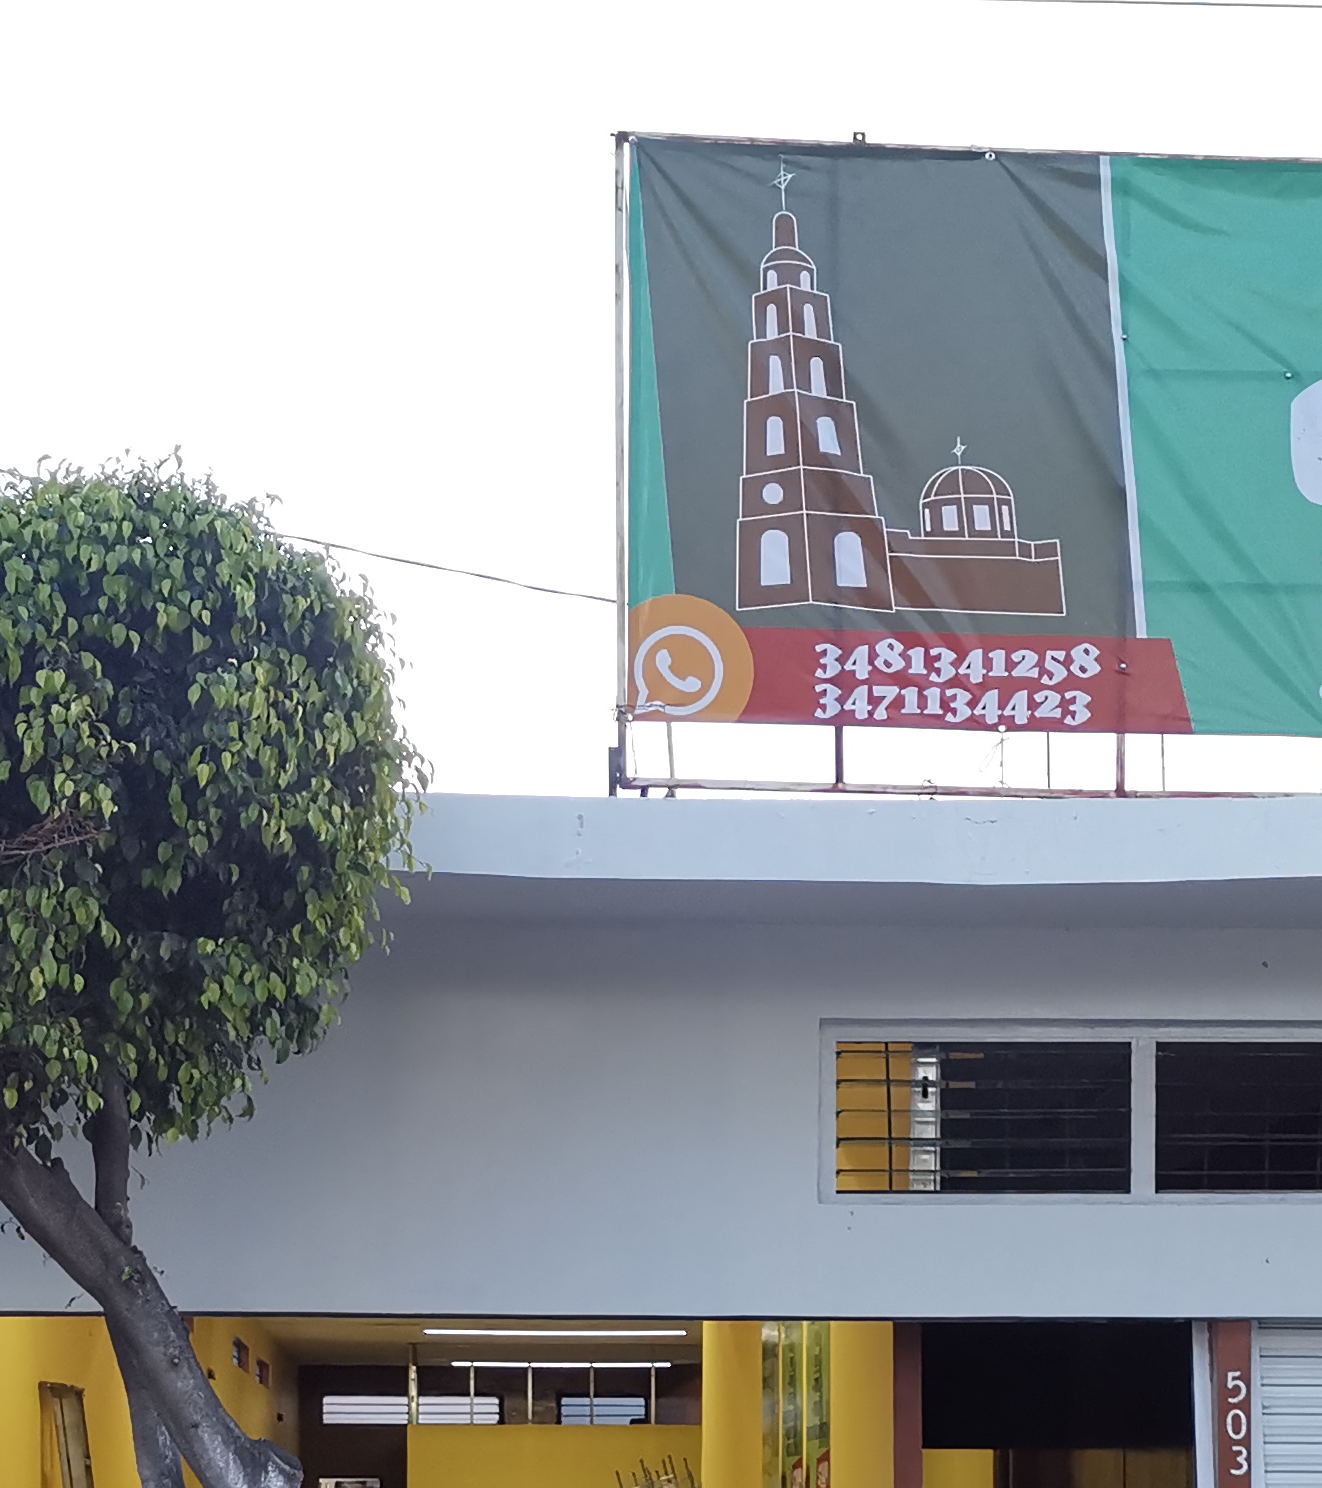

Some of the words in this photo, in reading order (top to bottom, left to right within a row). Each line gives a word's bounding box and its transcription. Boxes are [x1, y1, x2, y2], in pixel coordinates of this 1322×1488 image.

[814, 638, 1102, 686] 3481341258
[814, 683, 1092, 726] 3471134423
[1226, 1370, 1249, 1476] 503
